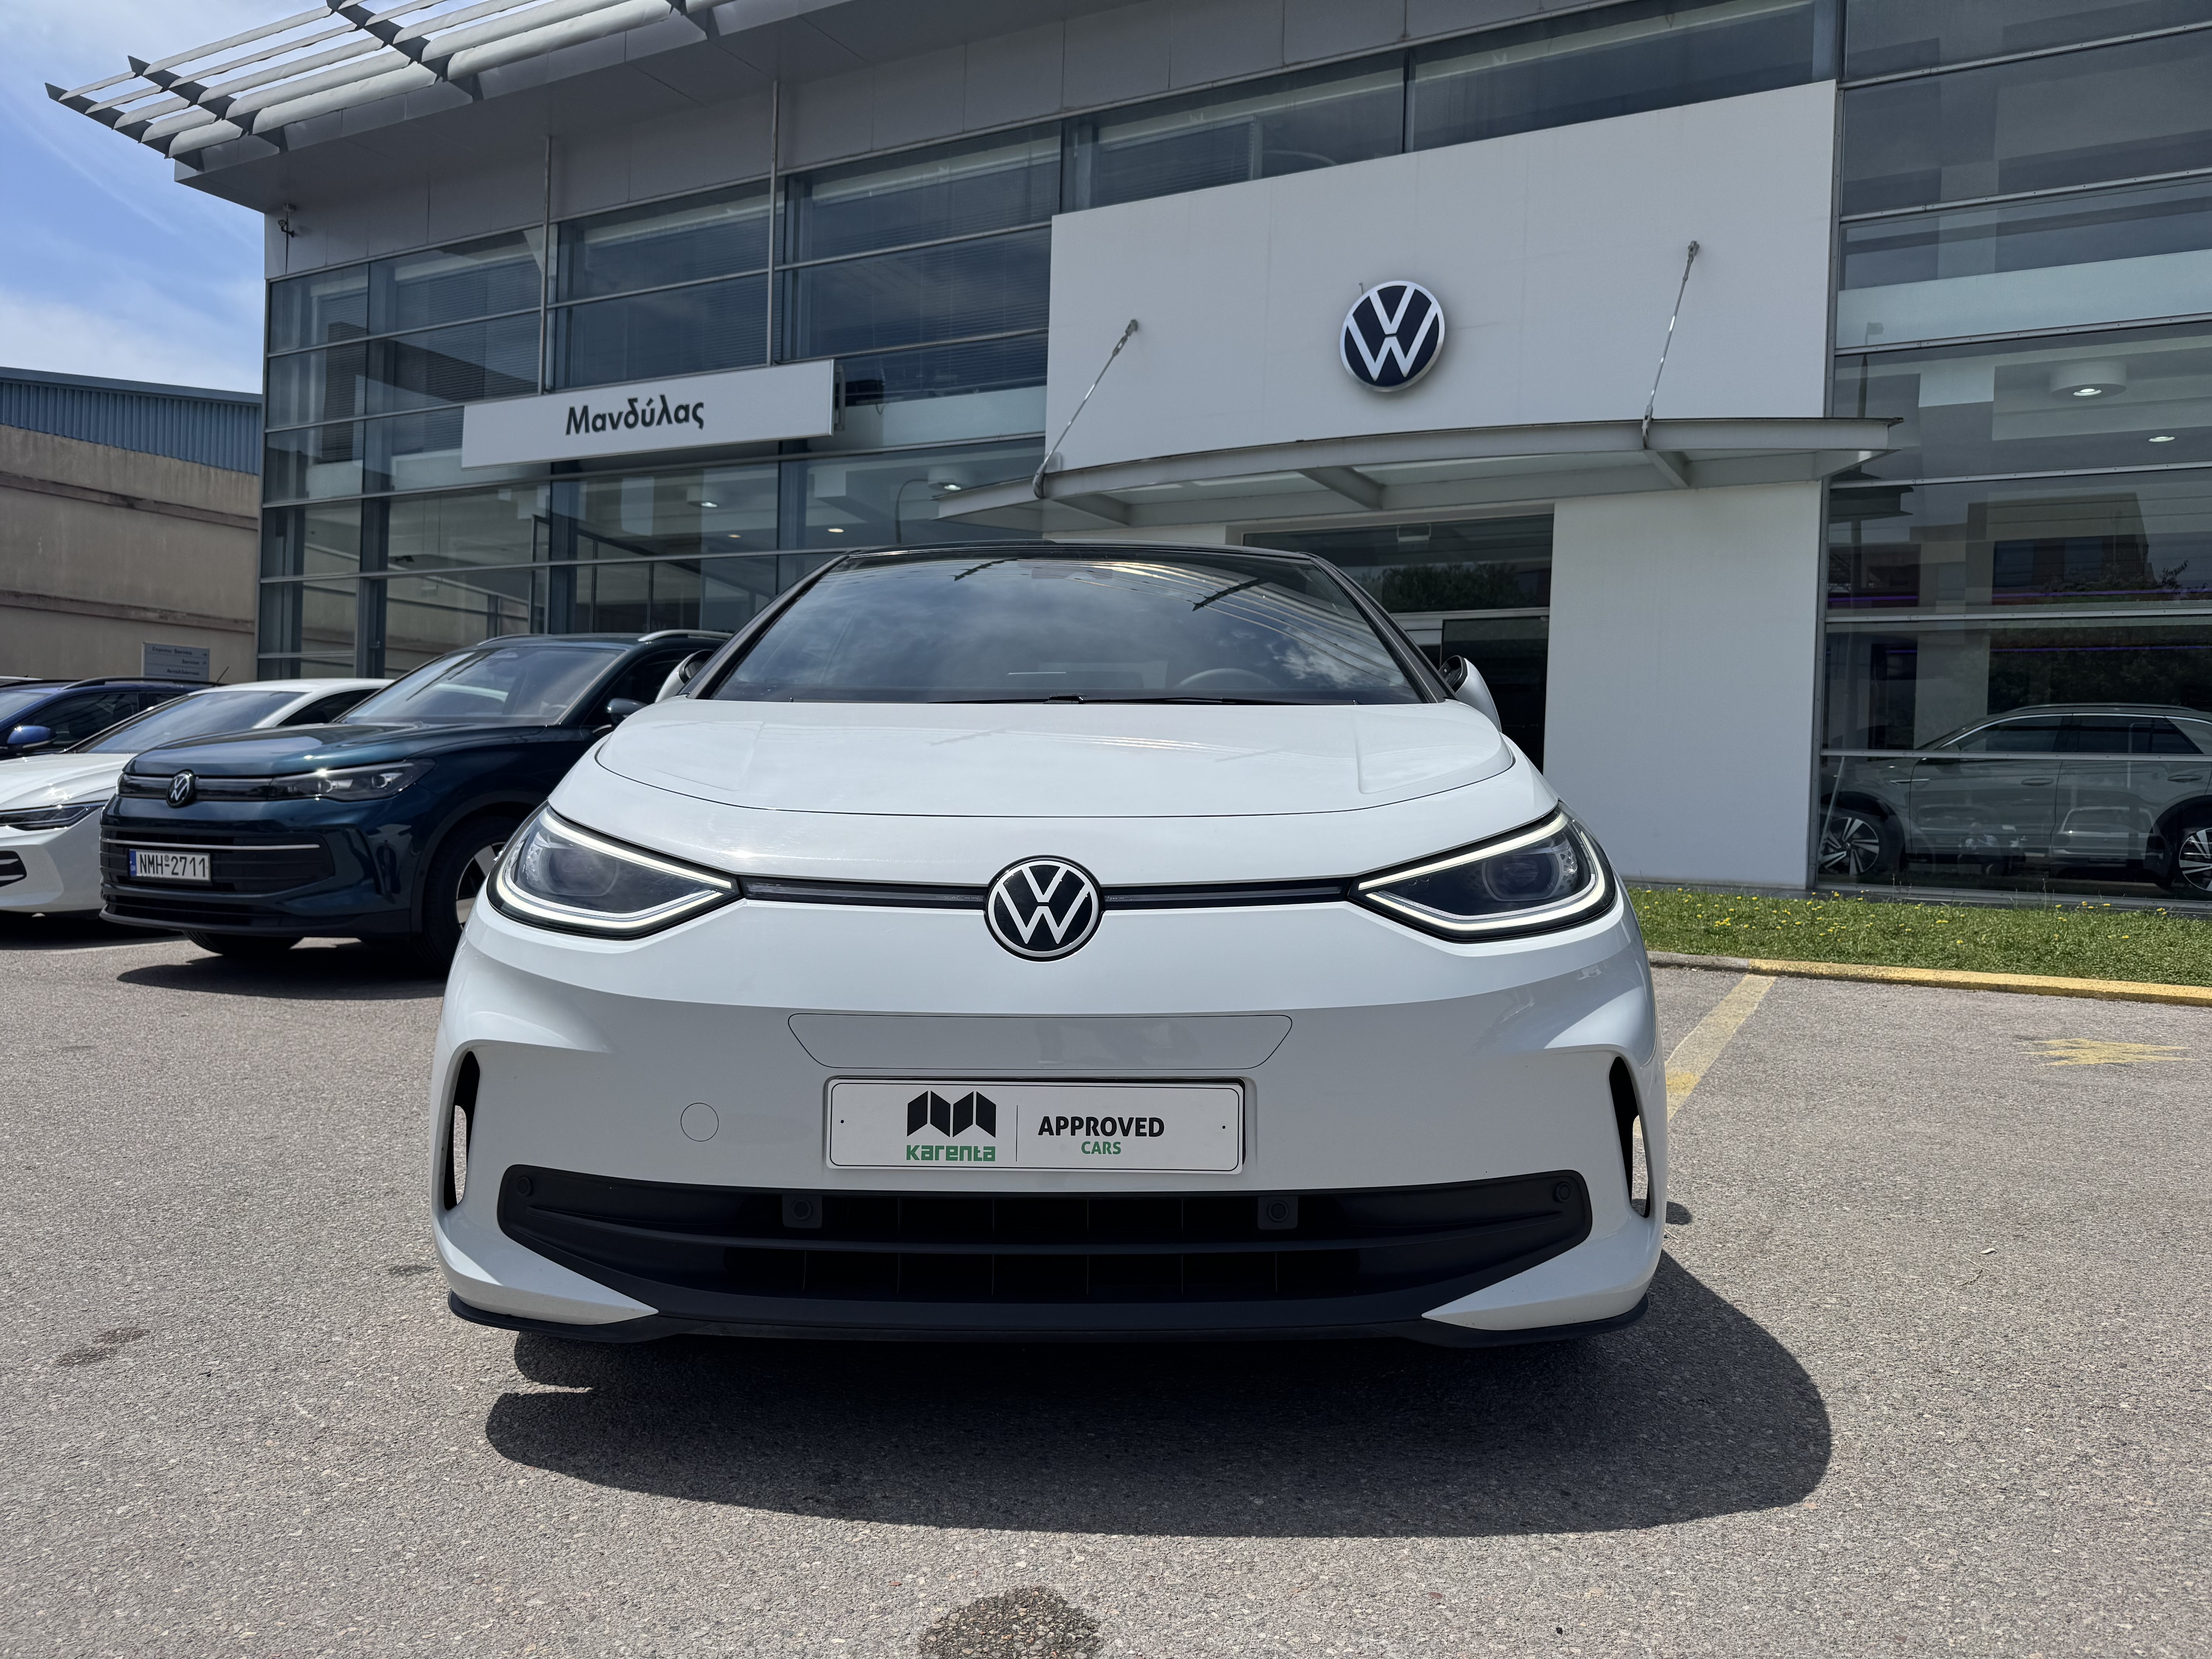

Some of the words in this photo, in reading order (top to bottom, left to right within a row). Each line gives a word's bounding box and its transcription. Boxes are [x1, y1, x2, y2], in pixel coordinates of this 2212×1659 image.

[565, 394, 704, 436] Μανδύλας
[1038, 1116, 1164, 1137] APPROVED
[1081, 1141, 1121, 1155] CARS
